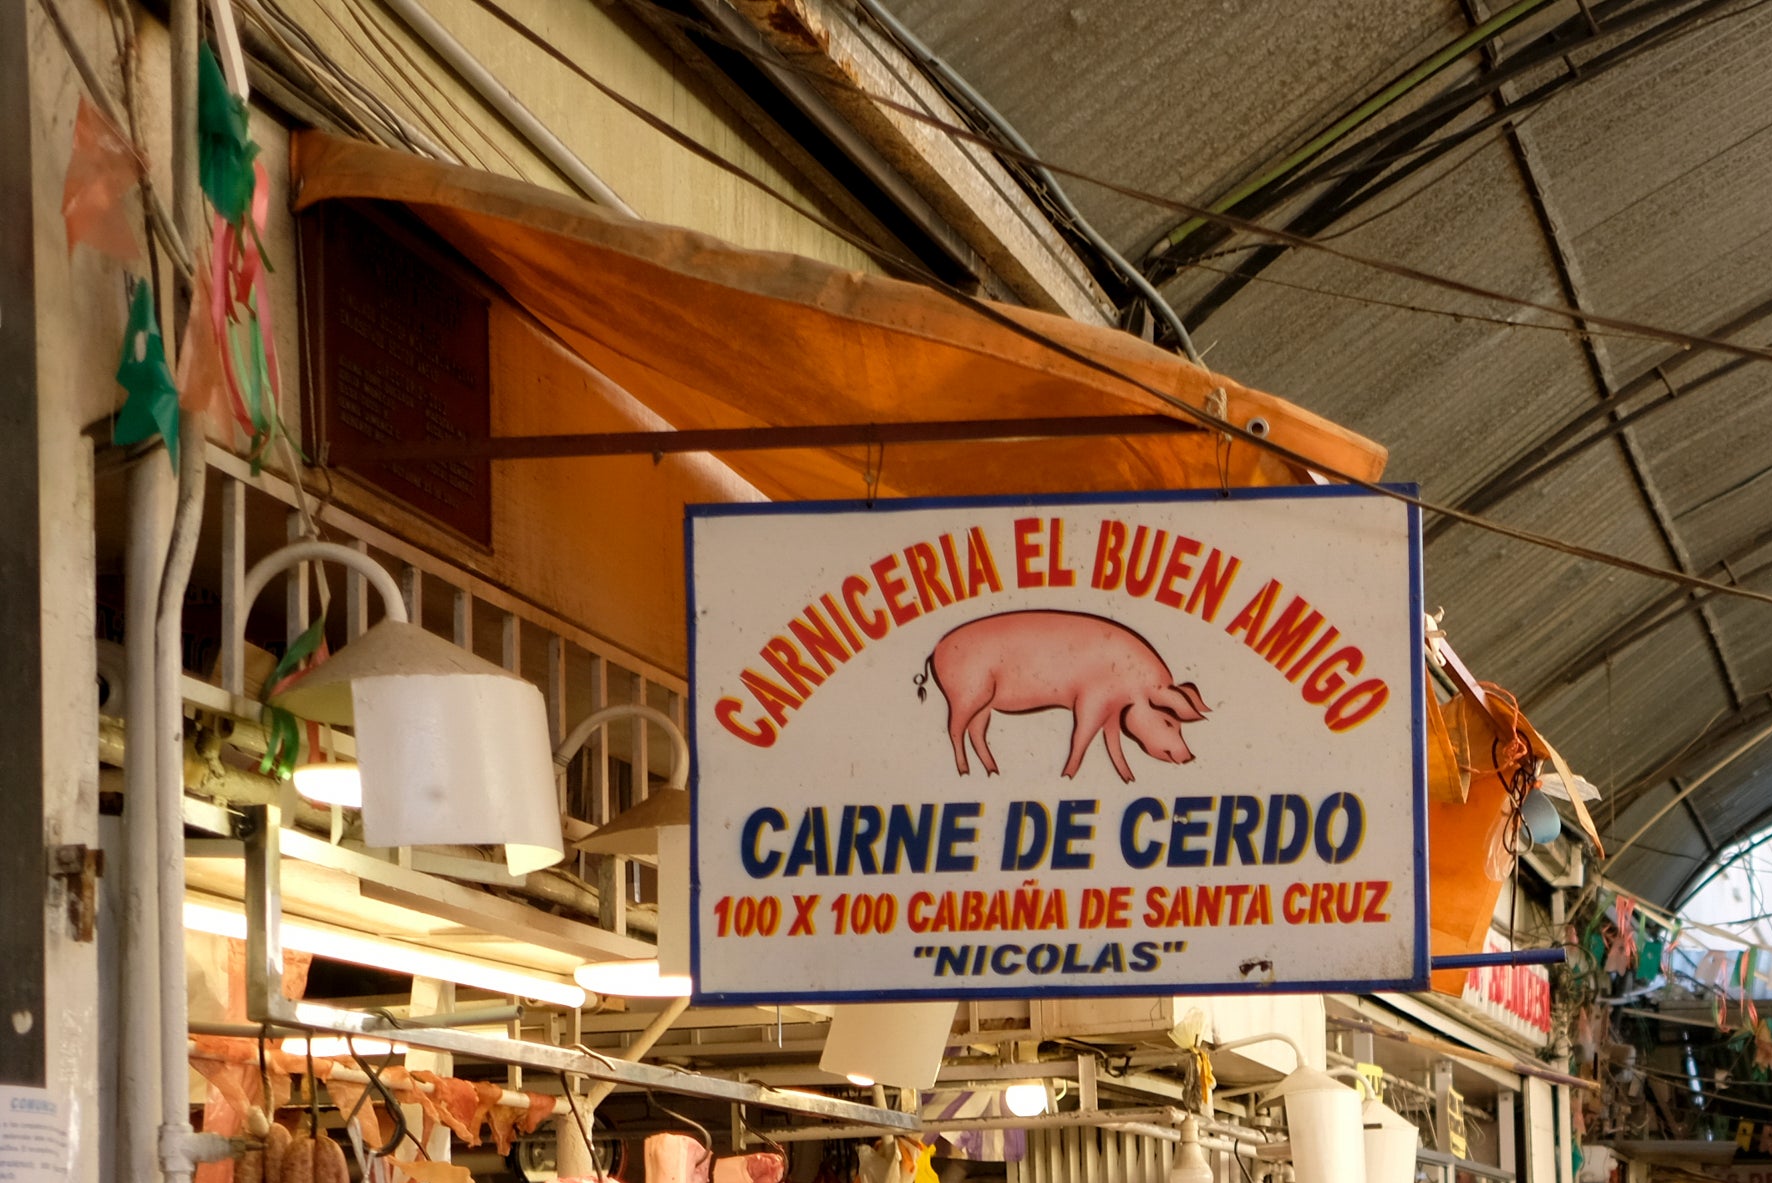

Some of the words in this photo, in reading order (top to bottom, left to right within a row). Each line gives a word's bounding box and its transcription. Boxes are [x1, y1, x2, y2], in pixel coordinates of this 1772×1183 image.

[714, 526, 1003, 748] CARNICERIA
[1014, 517, 1076, 588] EL
[1091, 519, 1242, 624] BUEN
[1225, 577, 1390, 734] AMIGO
[741, 802, 985, 879] CARNE
[1001, 799, 1101, 871] DE
[1120, 791, 1367, 869] CERDO
[714, 895, 782, 938] 100
[787, 894, 822, 936] X
[831, 892, 898, 935] 100
[907, 878, 1069, 933] CABAÑA
[1079, 887, 1135, 929] DE
[1143, 884, 1274, 928] SANTA
[1283, 881, 1393, 925] CRUZ
[914, 941, 1187, 977] "NICOLAS"
